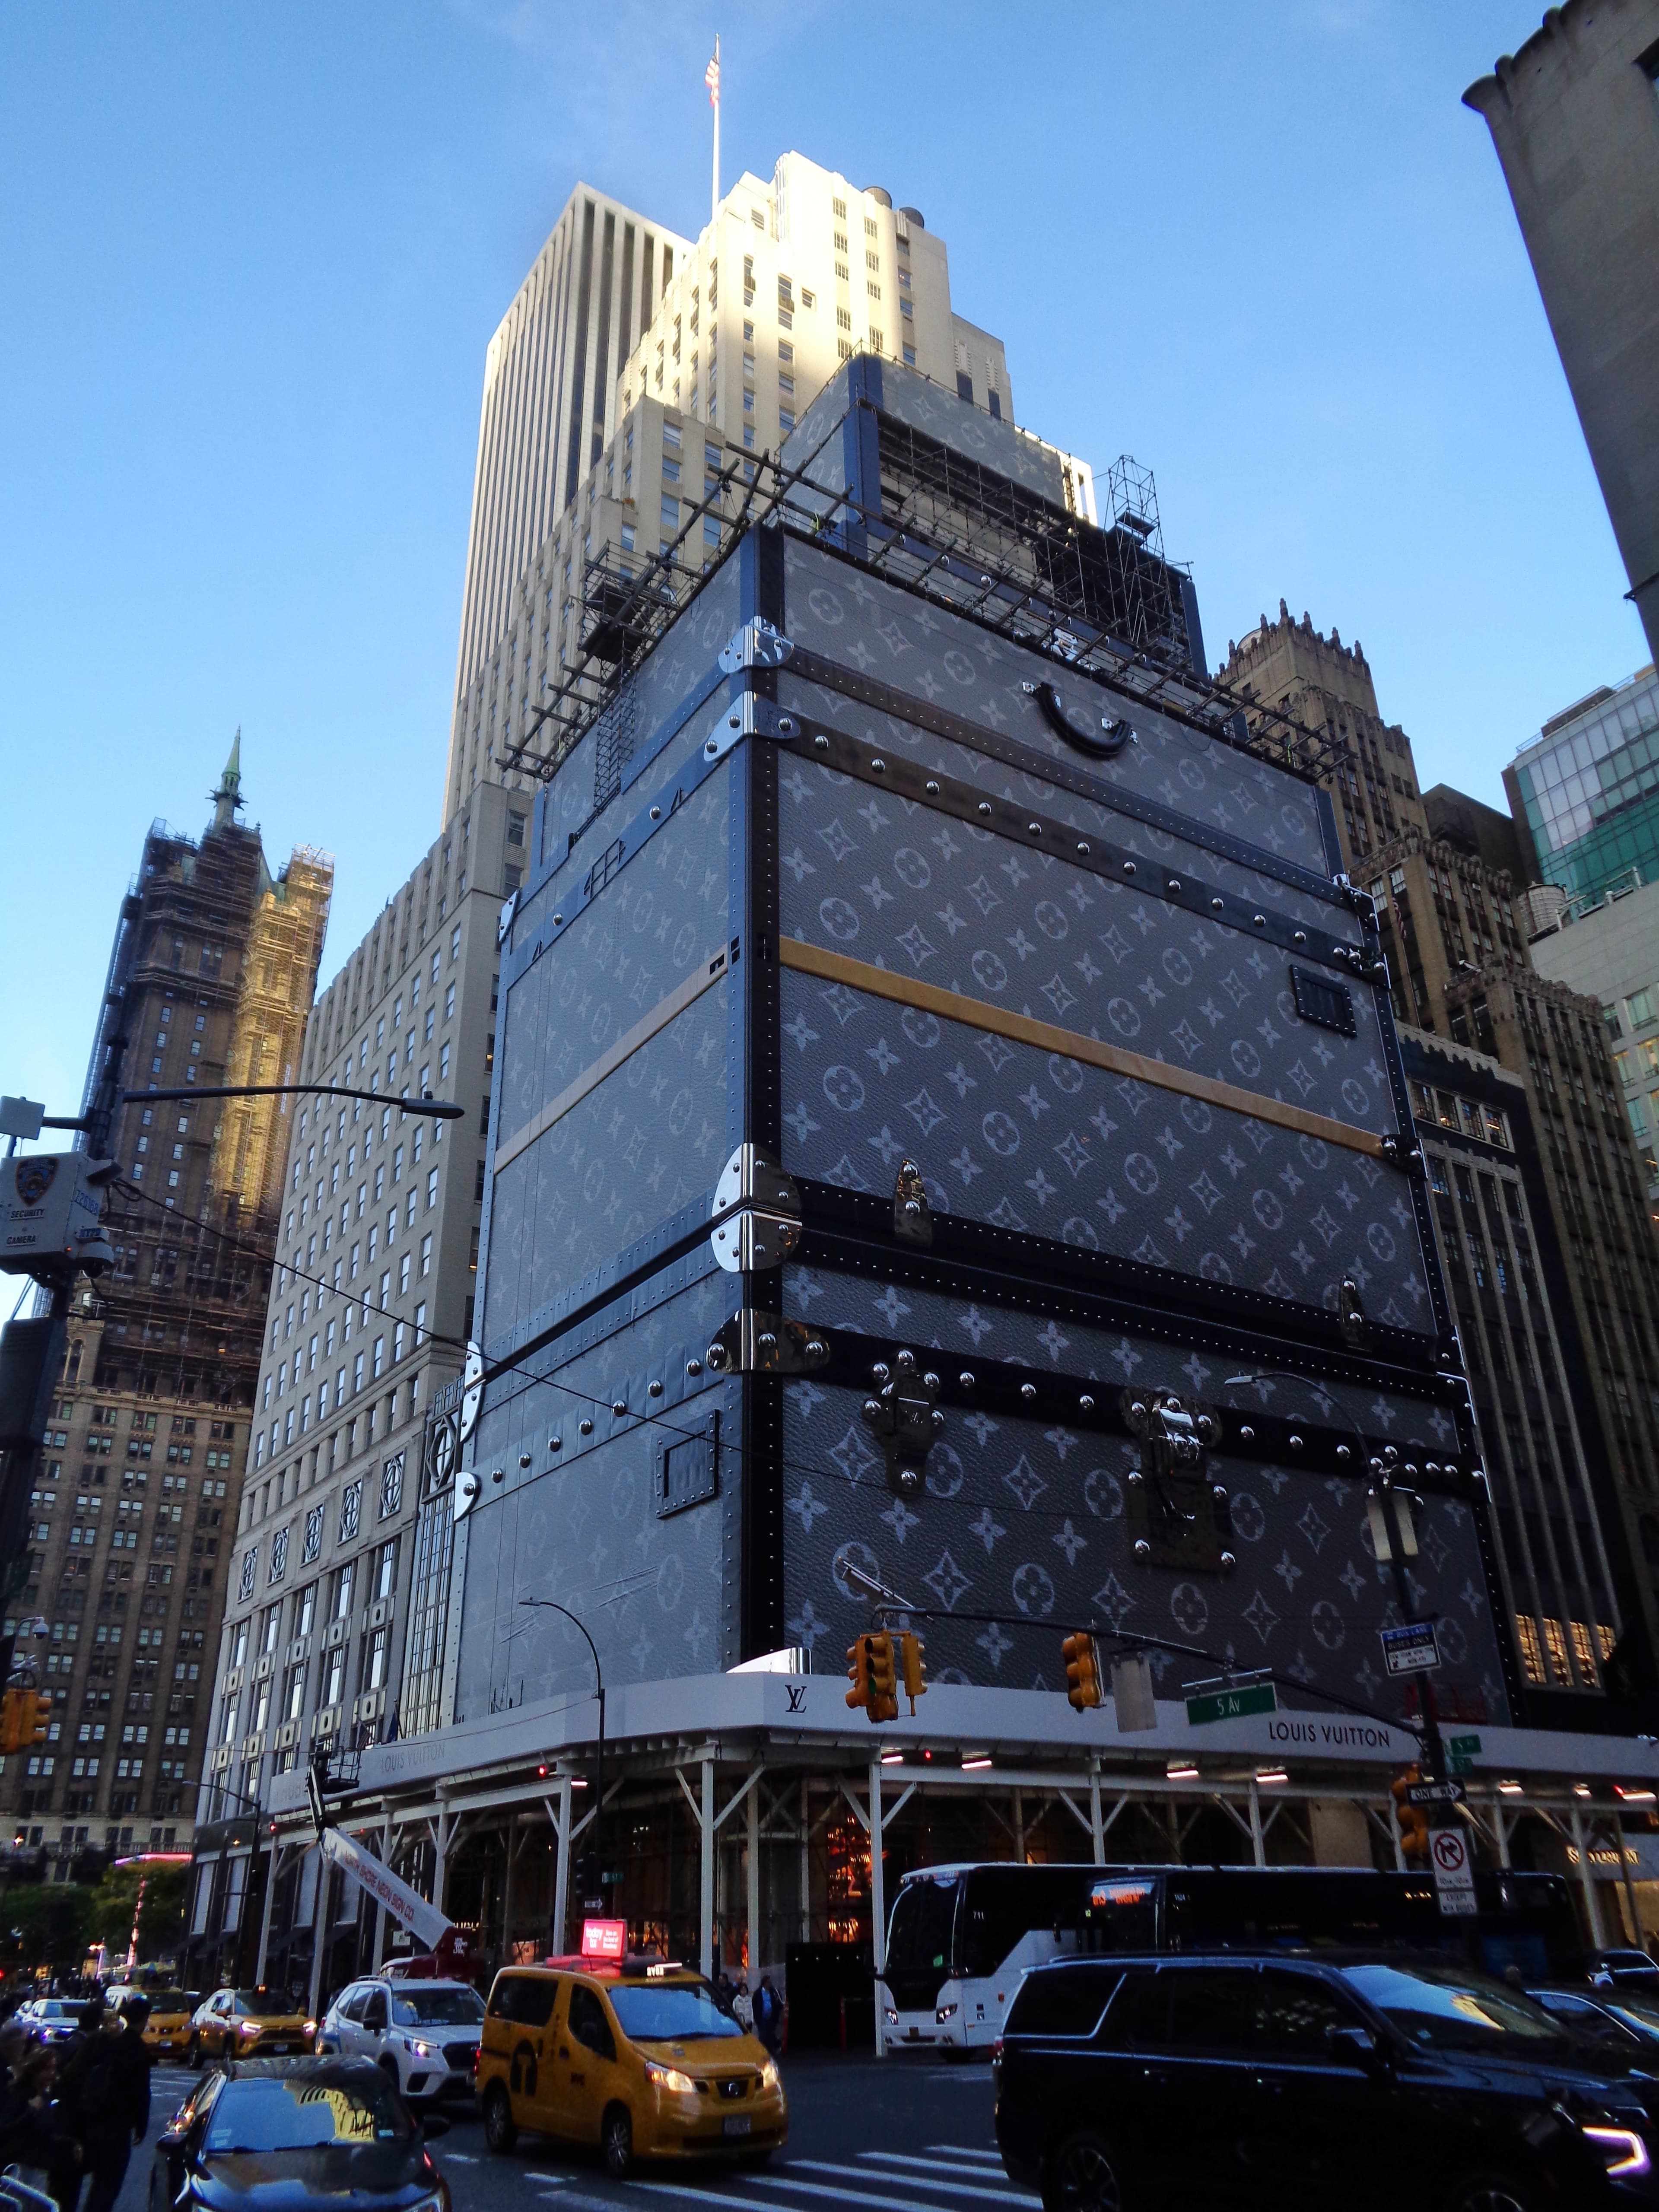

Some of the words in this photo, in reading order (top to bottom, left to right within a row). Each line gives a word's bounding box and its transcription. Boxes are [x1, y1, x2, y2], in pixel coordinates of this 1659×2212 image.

[10, 1209, 45, 1218] SECURITY
[6, 1235, 36, 1244] CAMERA
[785, 1684, 807, 1713] LV
[1216, 1698, 1224, 1715] 5
[1229, 1696, 1239, 1713] Av
[1269, 1721, 1316, 1743] LOUIS
[1321, 1725, 1390, 1748] VUITTON
[381, 1751, 404, 1773] LOUIS
[407, 1743, 445, 1766] VUITTON
[1415, 1788, 1433, 1800] ONE
[1440, 1785, 1457, 1797] WAY
[359, 1864, 377, 1888] SHORE
[376, 1880, 391, 1902] NEON
[391, 1893, 405, 1914] SIGN
[973, 1910, 984, 1920] 711
[586, 1926, 603, 1941] today
